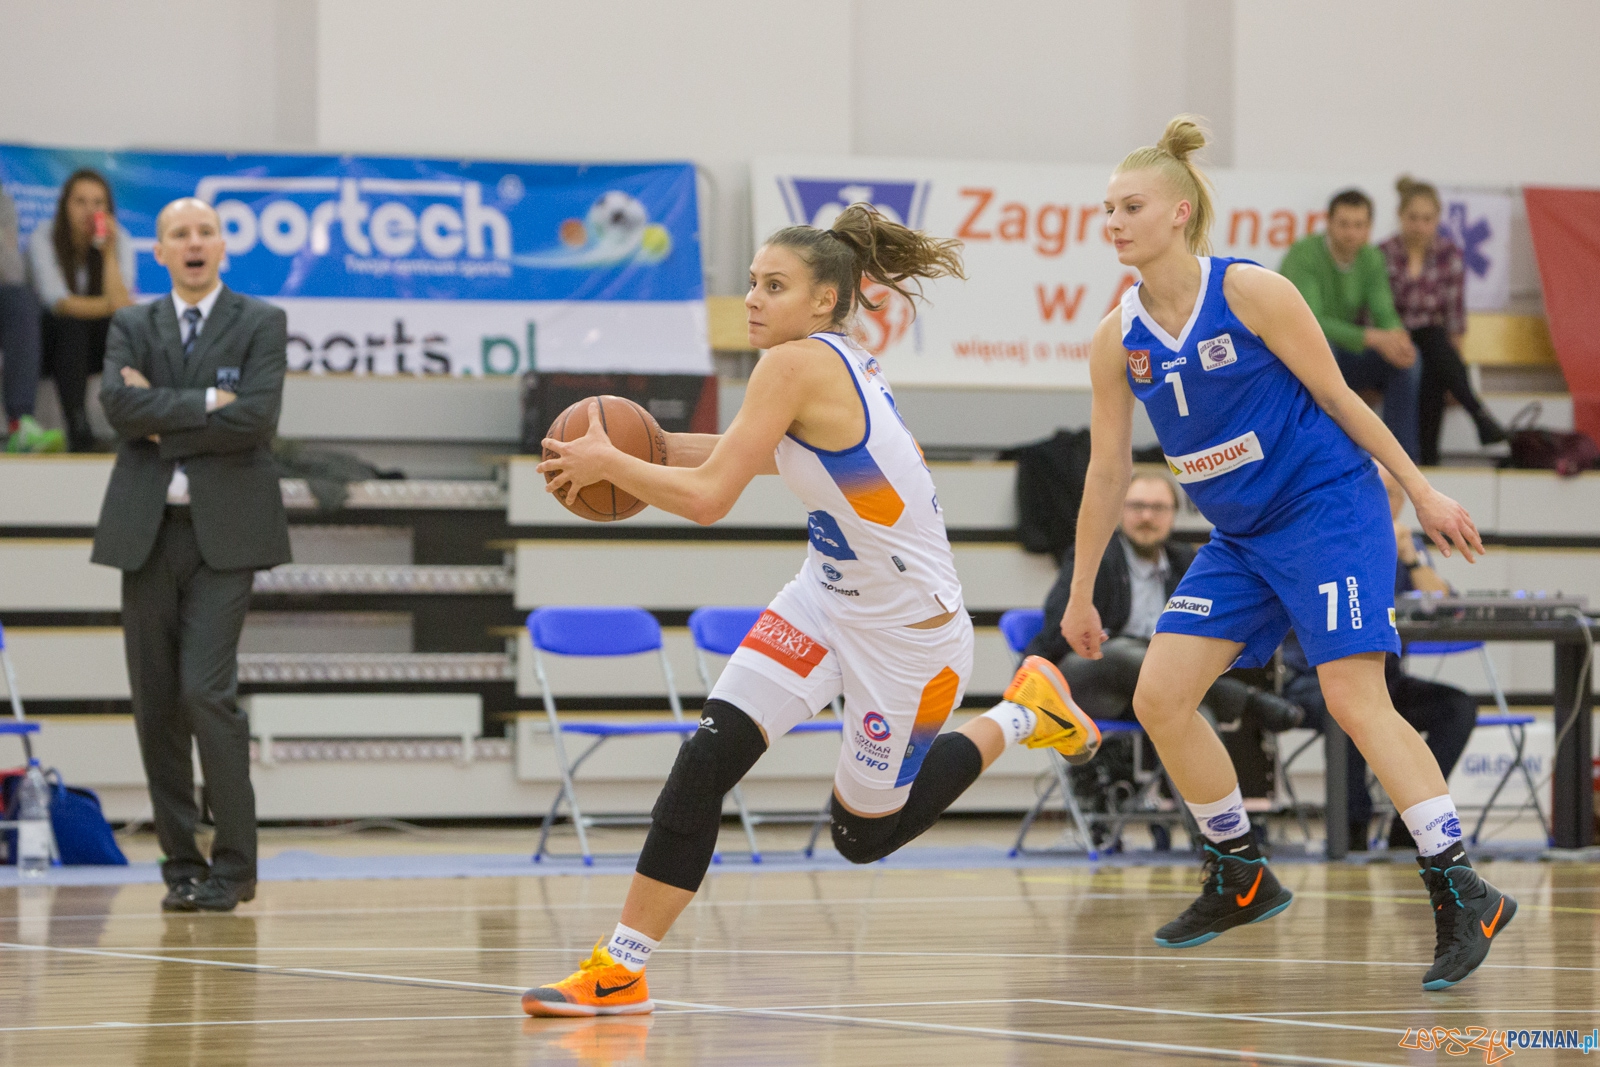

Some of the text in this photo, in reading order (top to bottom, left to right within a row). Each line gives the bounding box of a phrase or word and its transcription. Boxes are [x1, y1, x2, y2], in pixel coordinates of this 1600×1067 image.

[955, 187, 1114, 257] Zagr
[1033, 283, 1087, 322] w
[1164, 371, 1190, 417] 1
[1183, 442, 1249, 475] HAJDUK
[1318, 581, 1339, 632] 1
